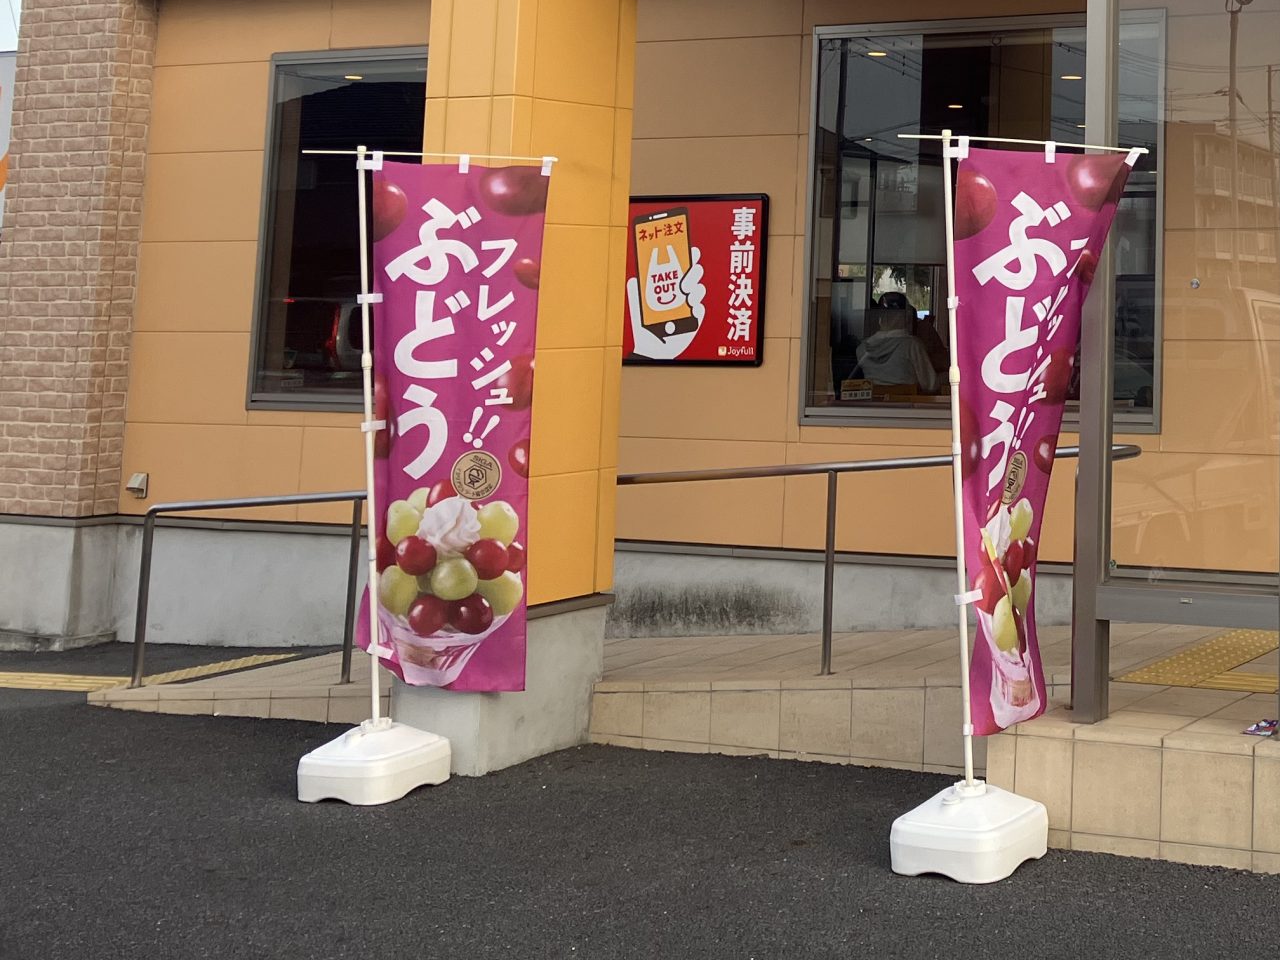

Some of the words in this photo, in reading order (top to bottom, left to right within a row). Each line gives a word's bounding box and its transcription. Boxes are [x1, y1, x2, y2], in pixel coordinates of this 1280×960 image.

[638, 221, 684, 242] ネット注文
[651, 270, 679, 284] TAKE
[727, 206, 757, 342] 事前決済
[654, 282, 677, 295] OUT
[384, 198, 482, 480] ぶどう
[971, 191, 1072, 496] ぶどう
[727, 346, 754, 357] Joyfull
